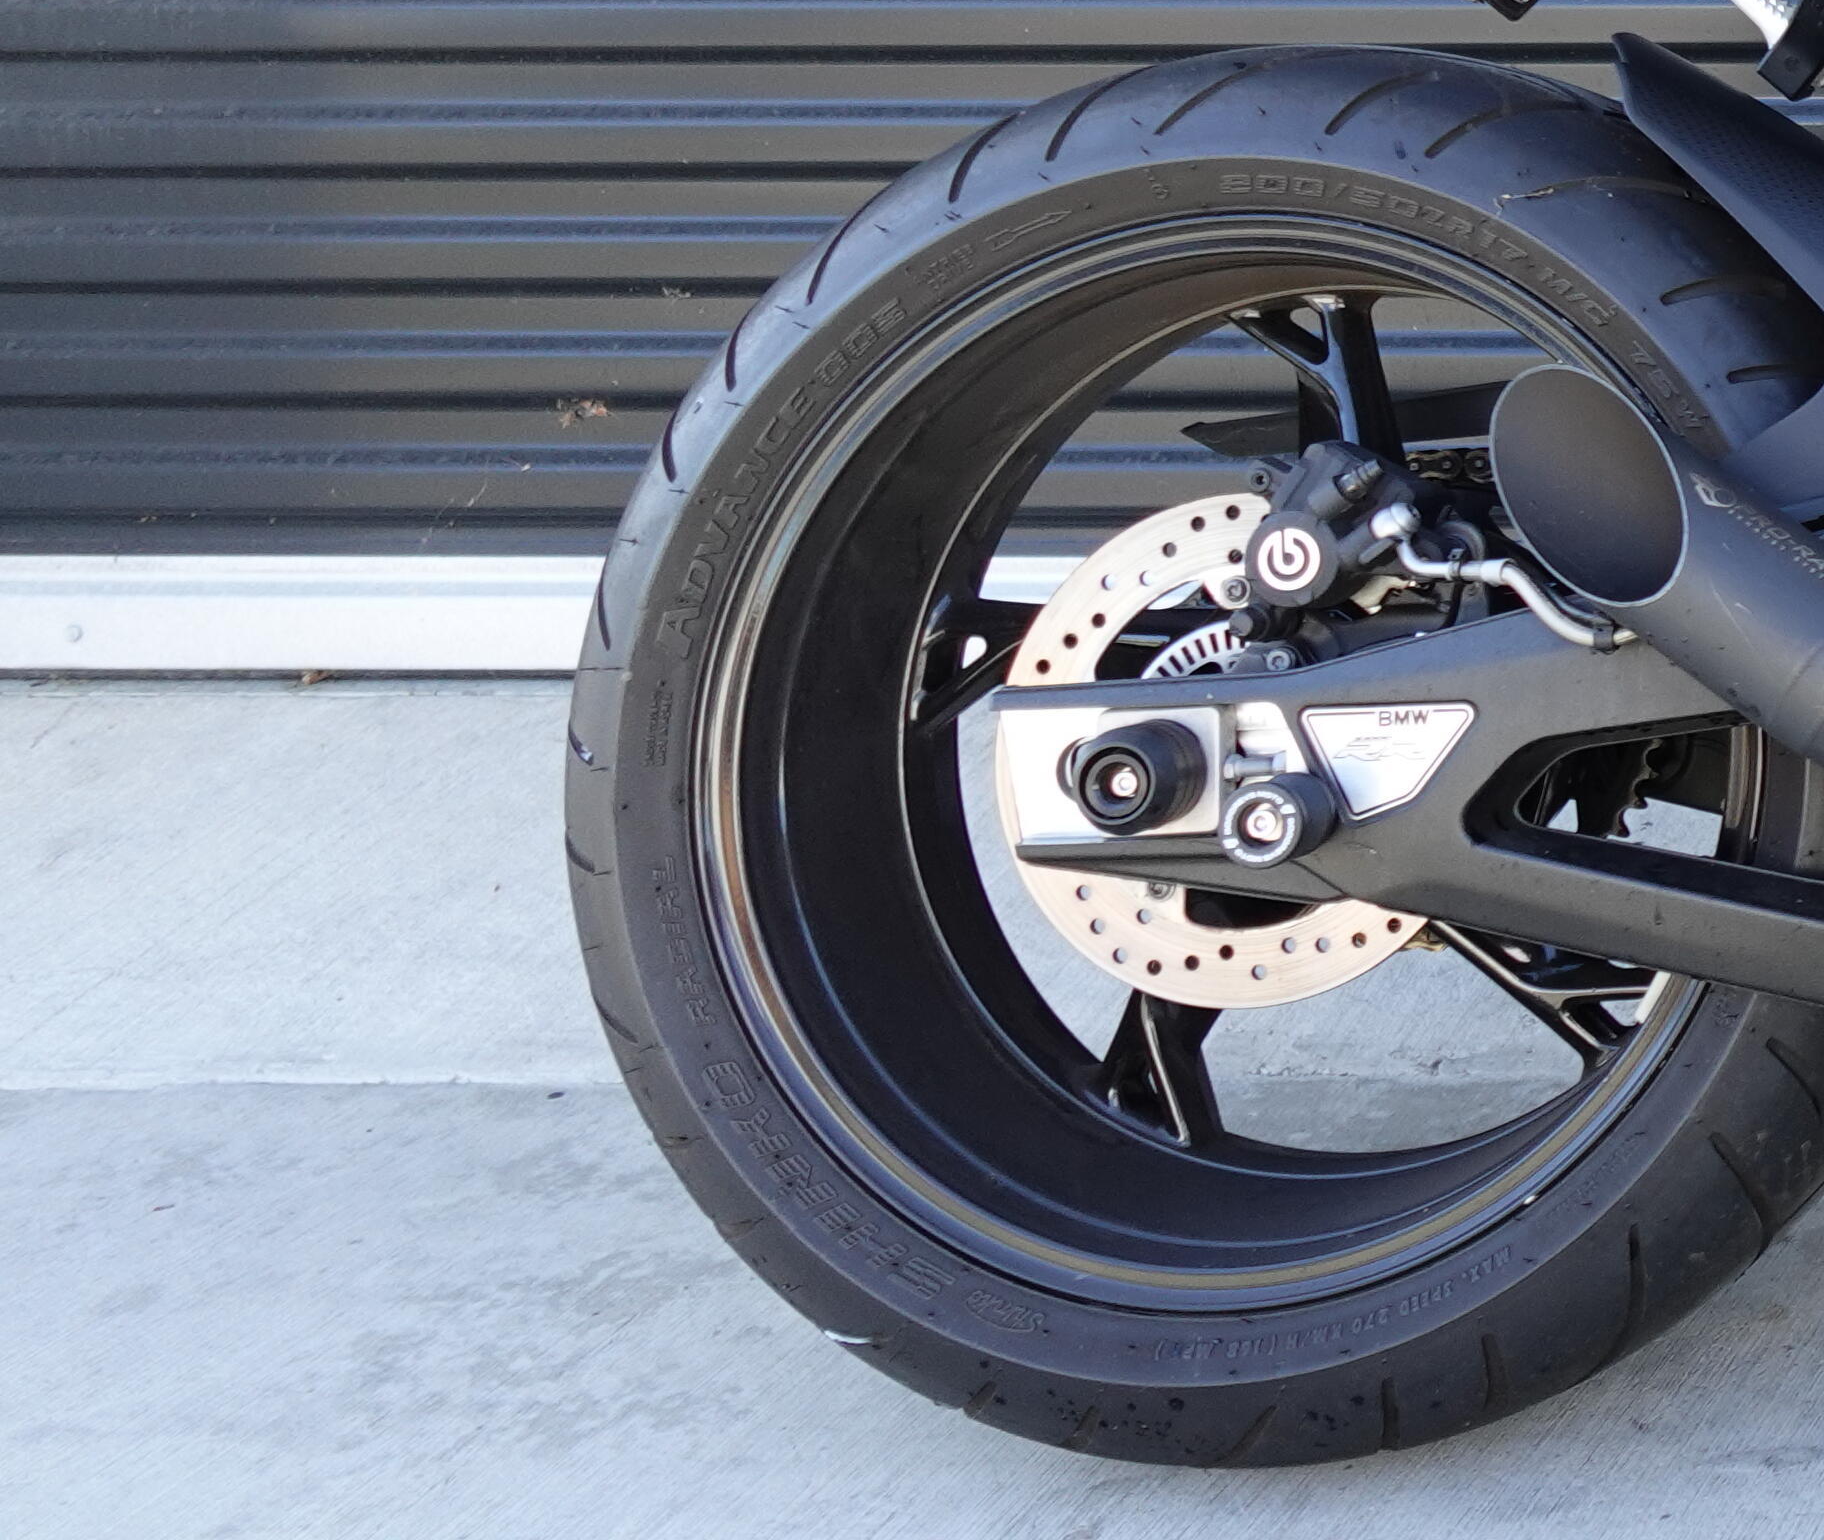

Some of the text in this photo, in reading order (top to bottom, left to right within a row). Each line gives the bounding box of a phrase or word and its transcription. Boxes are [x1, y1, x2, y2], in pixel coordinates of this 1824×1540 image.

[651, 382, 818, 662] ADVANCE
[1378, 710, 1430, 726] BMW
[698, 1055, 957, 1302] SHINKO
